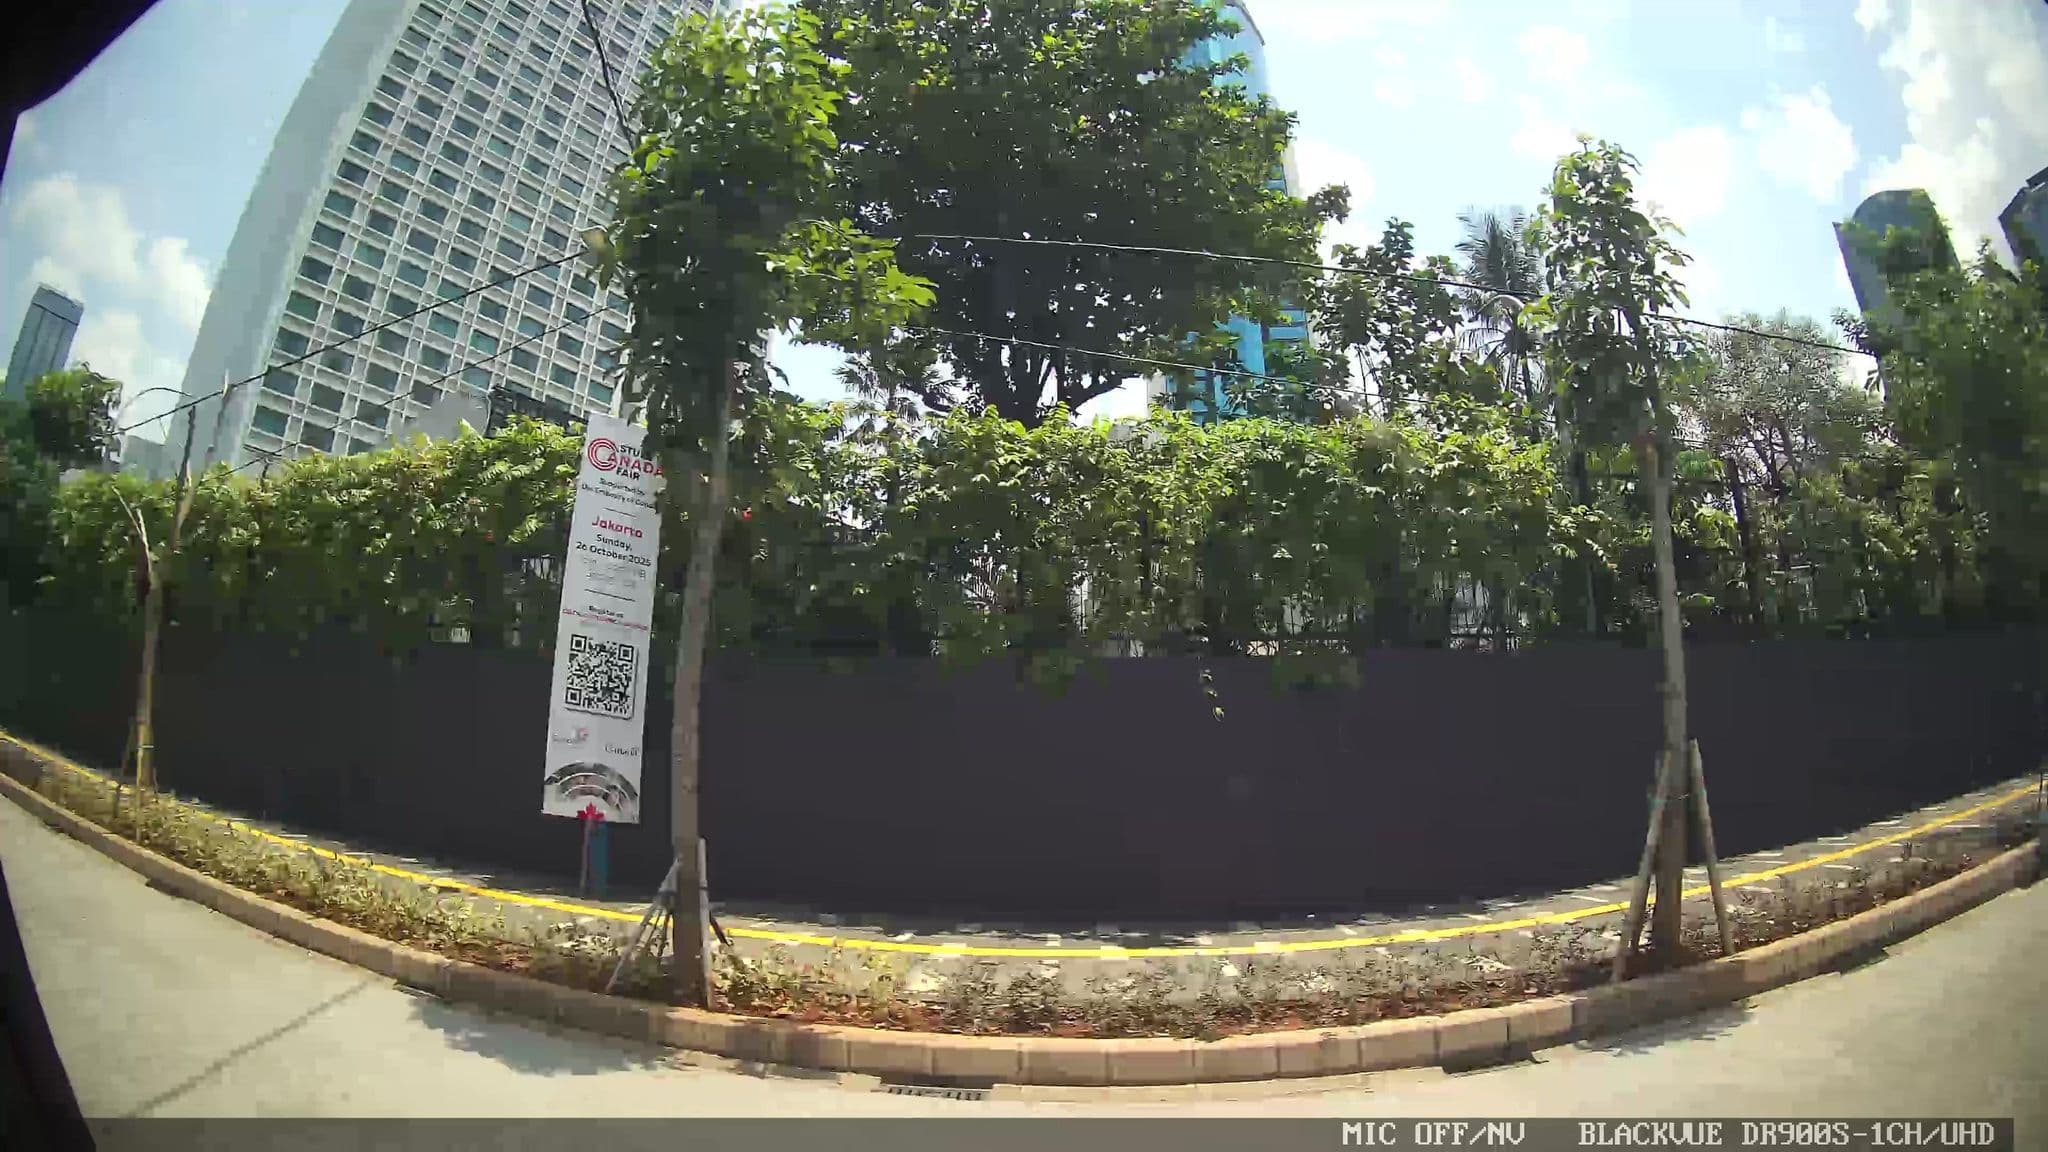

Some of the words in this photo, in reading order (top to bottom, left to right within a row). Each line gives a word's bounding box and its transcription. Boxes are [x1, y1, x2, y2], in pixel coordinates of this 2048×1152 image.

[616, 467, 641, 481] FAIR
[592, 516, 644, 539] Jakarta
[596, 534, 633, 552] Sunday,
[576, 541, 588, 551] 26
[589, 545, 628, 561] October
[628, 555, 652, 567] 2025
